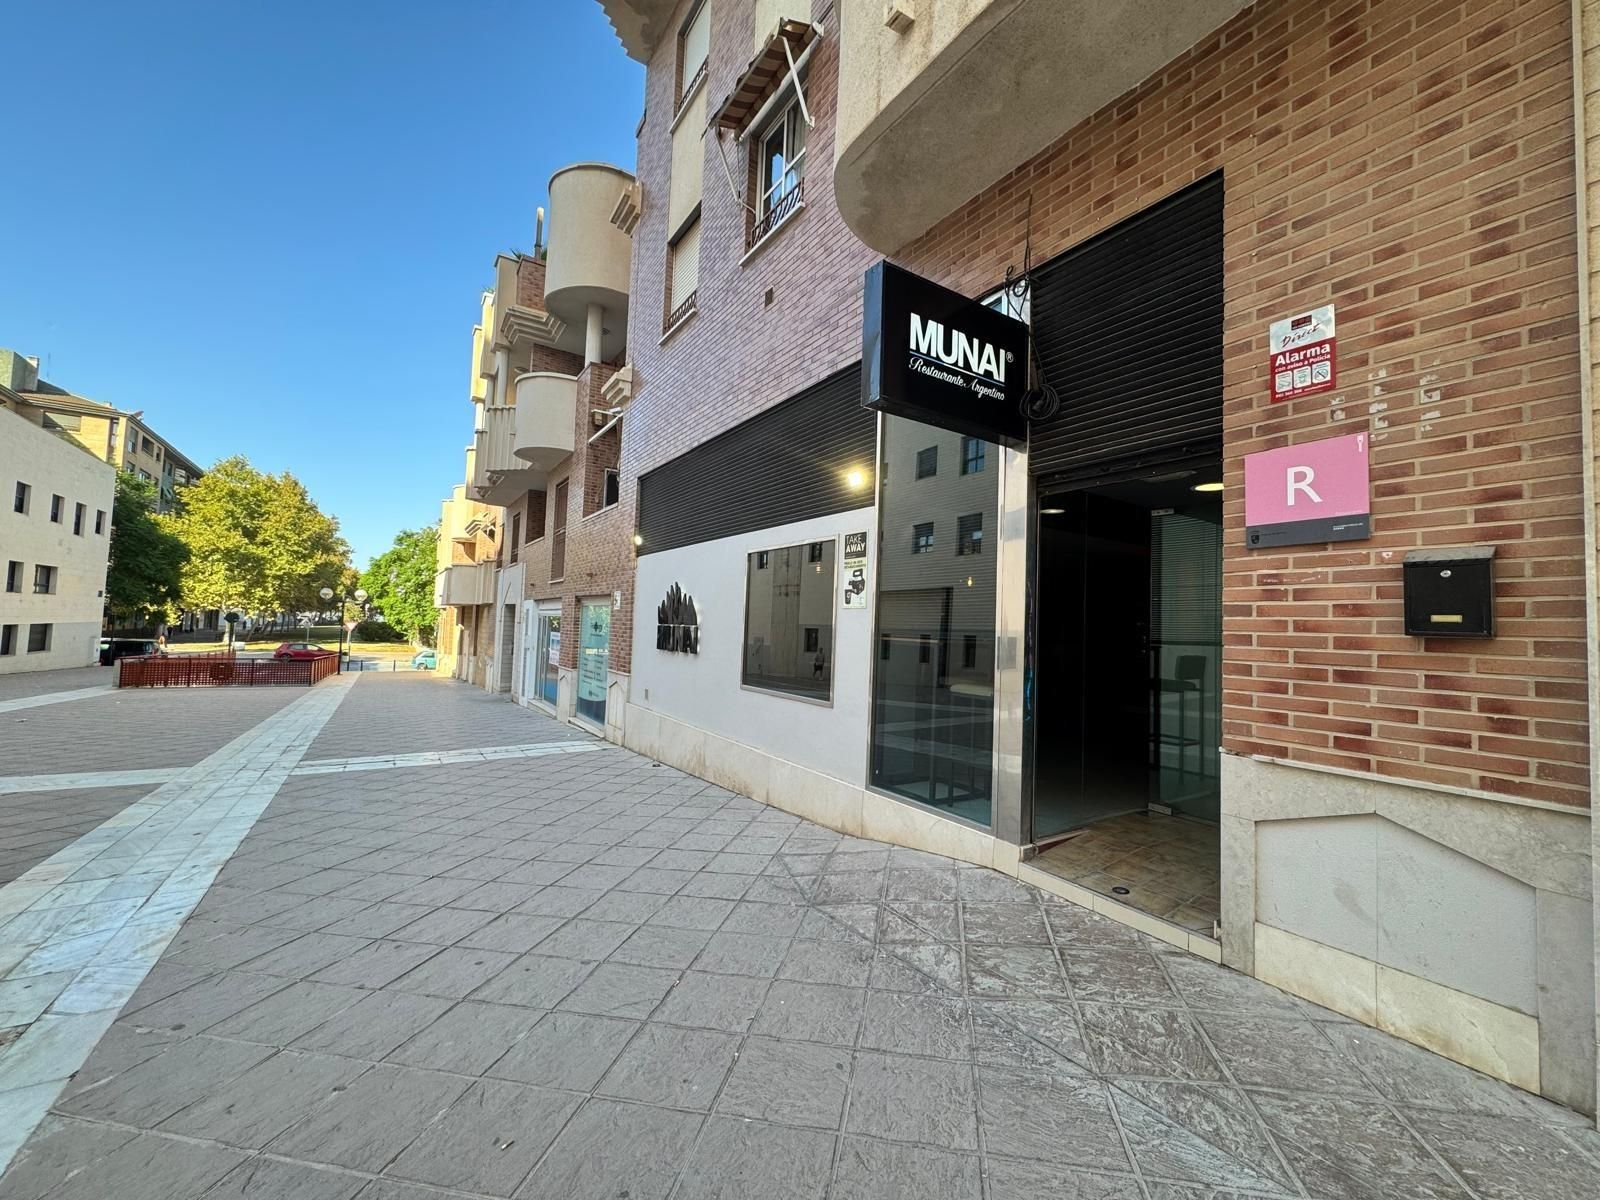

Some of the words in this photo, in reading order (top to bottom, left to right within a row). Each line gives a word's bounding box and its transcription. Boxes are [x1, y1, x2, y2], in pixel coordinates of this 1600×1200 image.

[1275, 344, 1331, 366] Alarma
[1287, 361, 1303, 370] aviso
[909, 357, 964, 387] Restaurante
[965, 379, 1005, 400] Argentino
[1287, 465, 1322, 506] R
[846, 534, 863, 544] TAKE
[846, 543, 866, 553] AWAY
[657, 626, 698, 654] MUNAI
